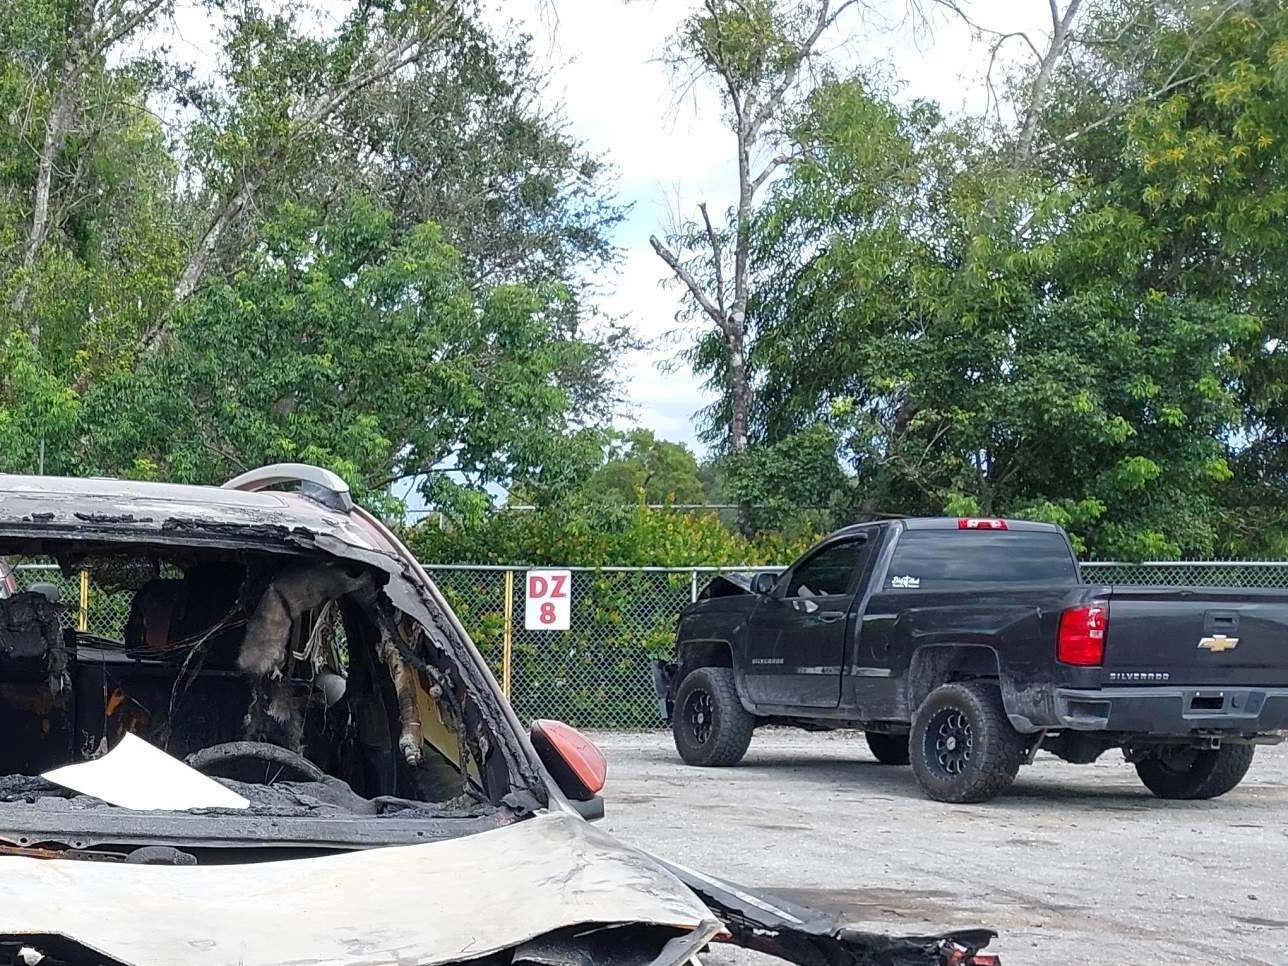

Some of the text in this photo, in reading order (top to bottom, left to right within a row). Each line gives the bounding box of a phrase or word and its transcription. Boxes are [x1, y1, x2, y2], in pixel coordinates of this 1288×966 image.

[529, 575, 568, 599] DZ
[539, 602, 556, 624] 8
[1109, 672, 1170, 681] SILVERADO
